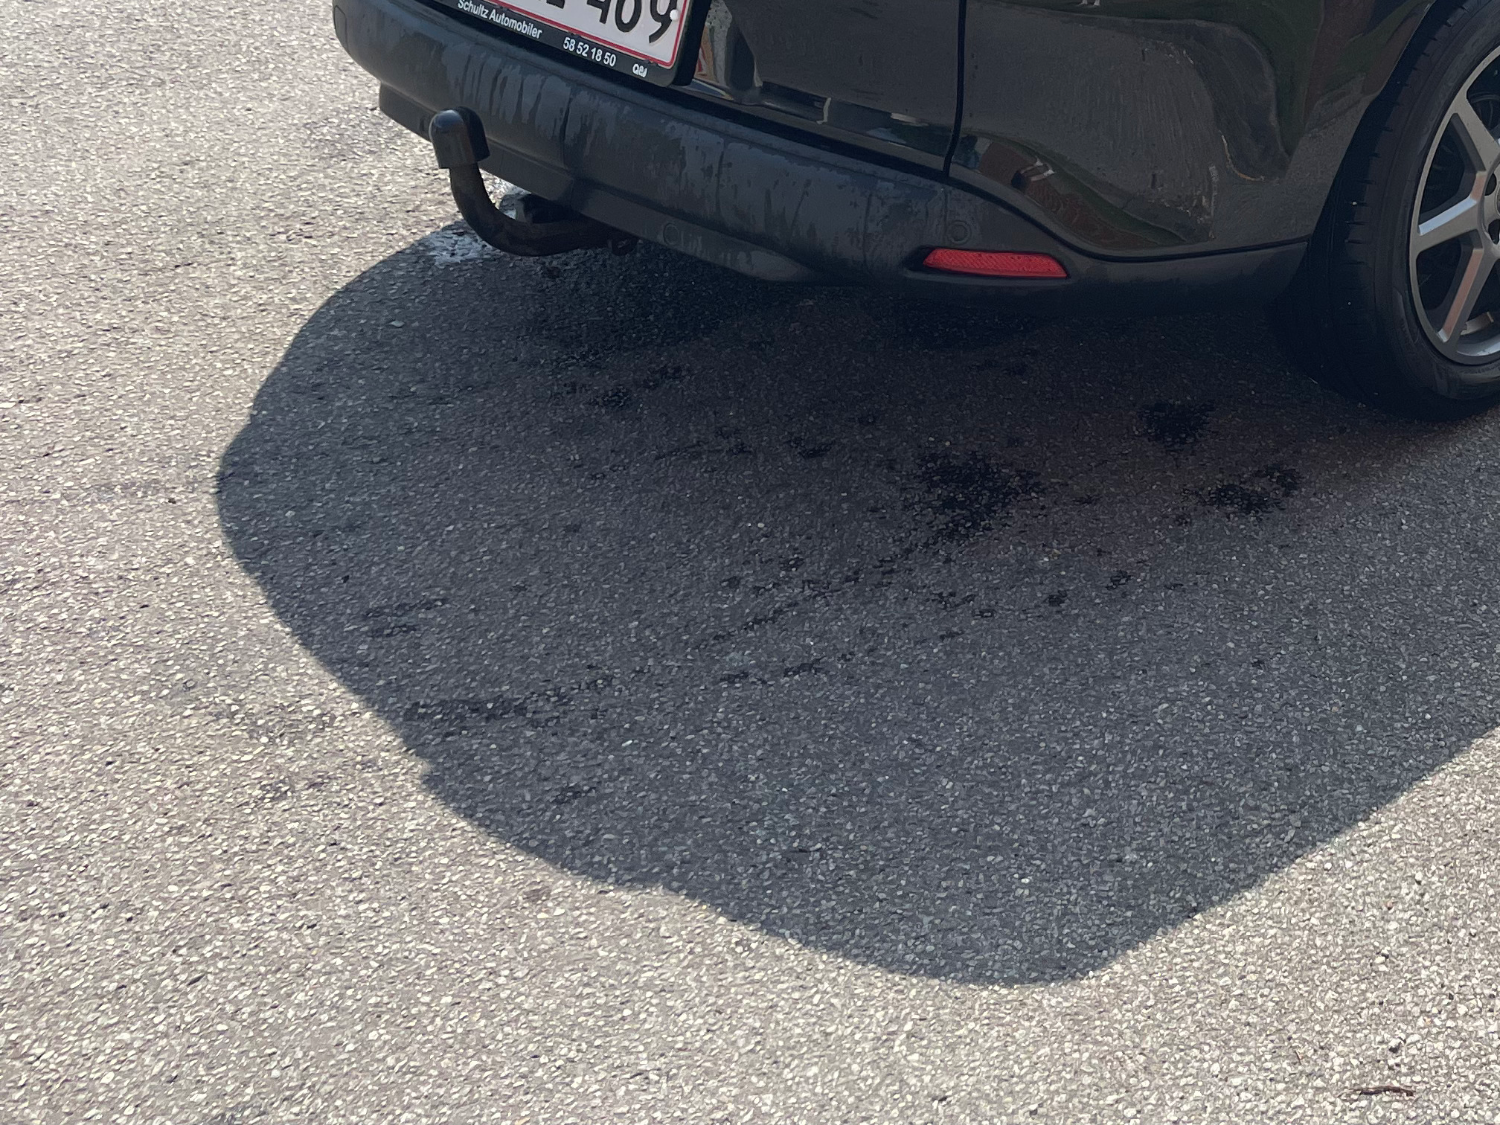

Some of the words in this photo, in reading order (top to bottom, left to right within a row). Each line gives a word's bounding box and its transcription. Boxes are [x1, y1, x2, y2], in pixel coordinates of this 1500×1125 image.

[489, 8, 543, 39] Automobiler
[563, 36, 576, 52] 58
[576, 41, 589, 57] 52
[591, 47, 603, 62] 18
[603, 52, 616, 67] 50
